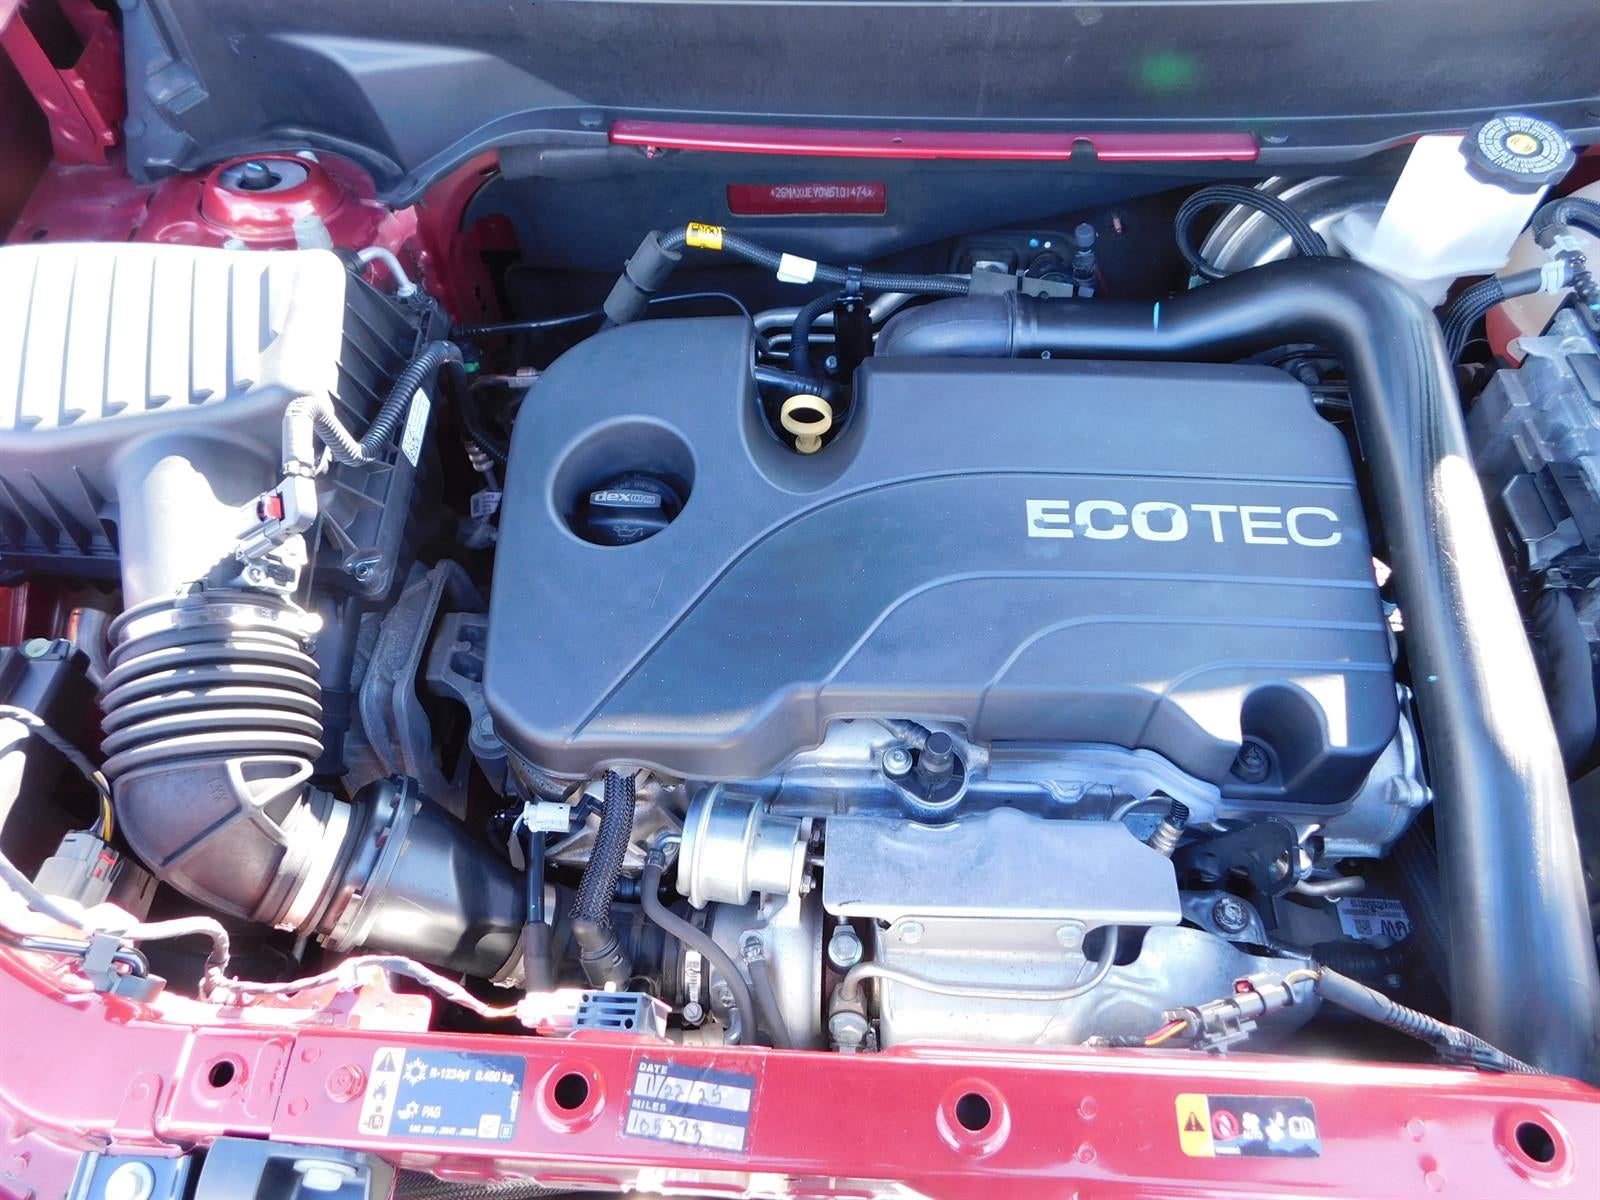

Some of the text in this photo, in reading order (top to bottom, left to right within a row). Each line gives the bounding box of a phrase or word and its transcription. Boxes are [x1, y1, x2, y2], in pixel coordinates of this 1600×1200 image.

[1026, 499, 1342, 547] ECOTEC
[638, 1062, 668, 1074] DATE
[501, 1071, 514, 1085] kg
[421, 1105, 442, 1119] PAG
[631, 1099, 666, 1112] MILES
